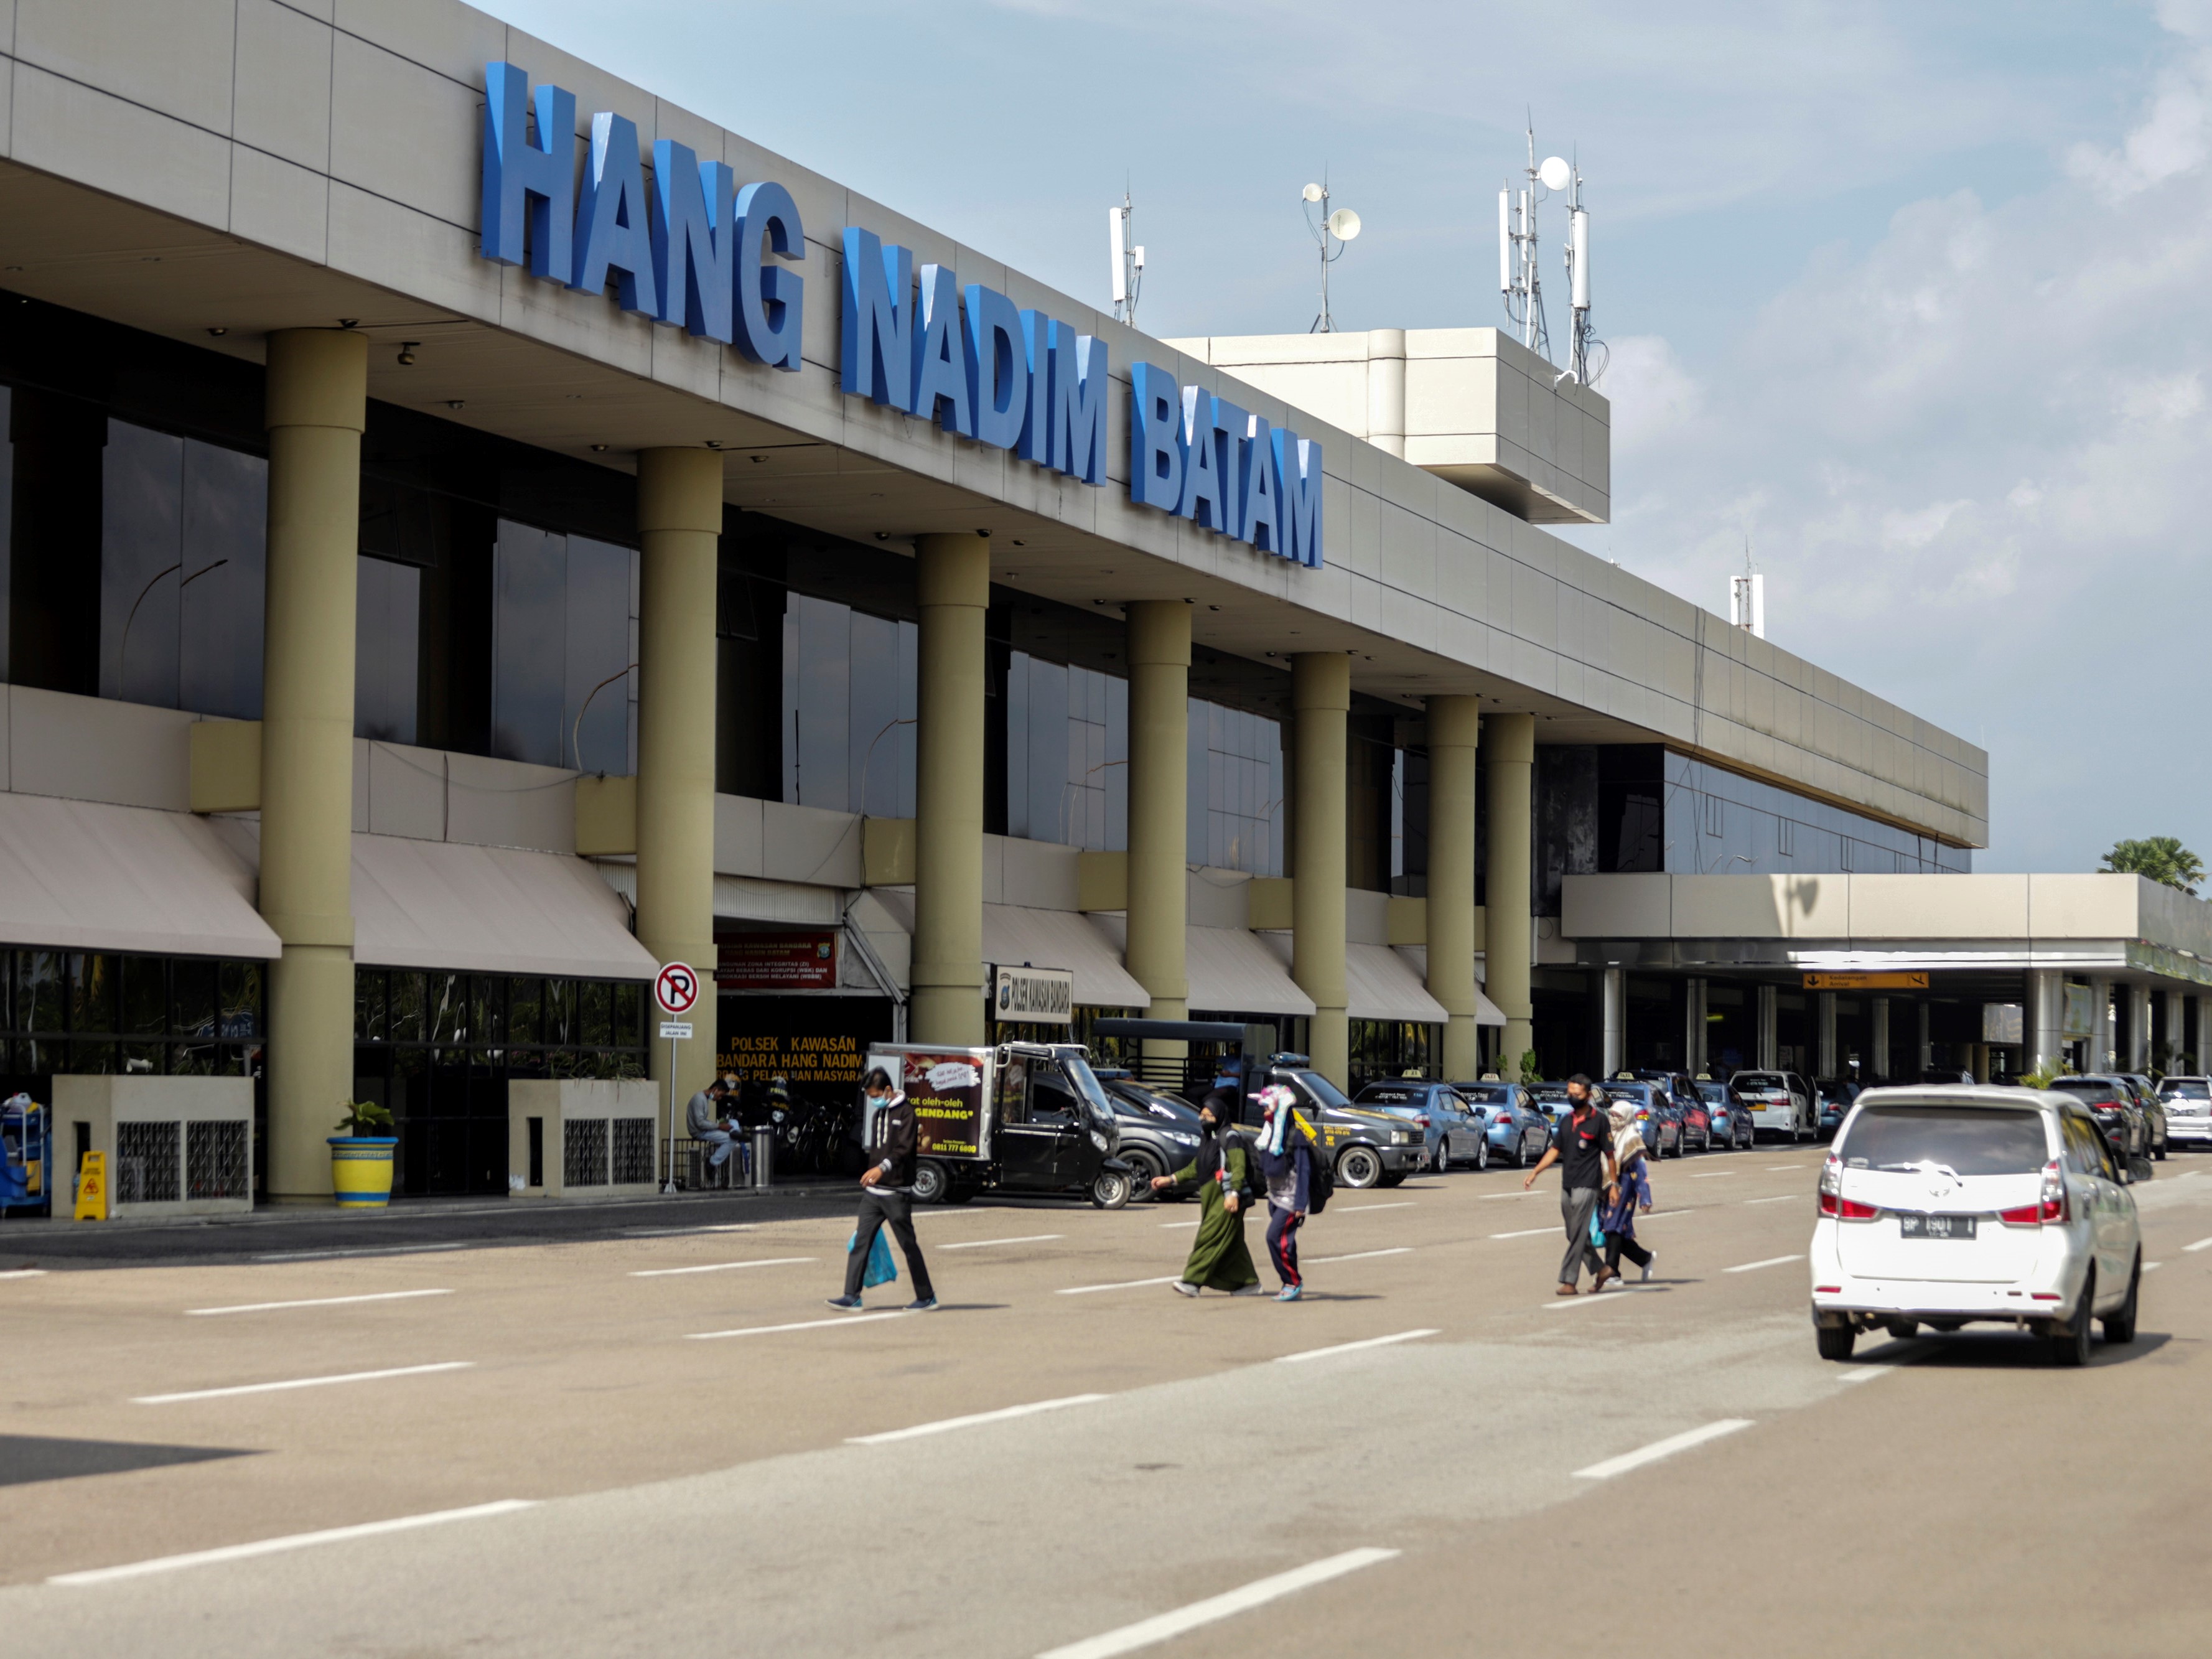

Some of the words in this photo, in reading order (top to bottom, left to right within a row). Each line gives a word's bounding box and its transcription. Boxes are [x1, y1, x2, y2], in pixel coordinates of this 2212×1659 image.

[482, 62, 805, 372] HANG
[841, 227, 1108, 487] NADIM
[1131, 362, 1323, 569] BATAM
[671, 974, 689, 1004] P
[1011, 976, 1029, 1012] POLSEK
[1050, 979, 1070, 1014] BANDARA
[732, 1037, 778, 1051] POLSEK
[791, 1037, 856, 1052] KAWASAN
[717, 1054, 777, 1067] BANDARA
[782, 1054, 817, 1068] HANG
[823, 1054, 862, 1068] NADIM
[922, 1097, 963, 1108] oleh-oleh
[948, 1144, 959, 1152] 777
[1904, 1217, 1919, 1231] BP
